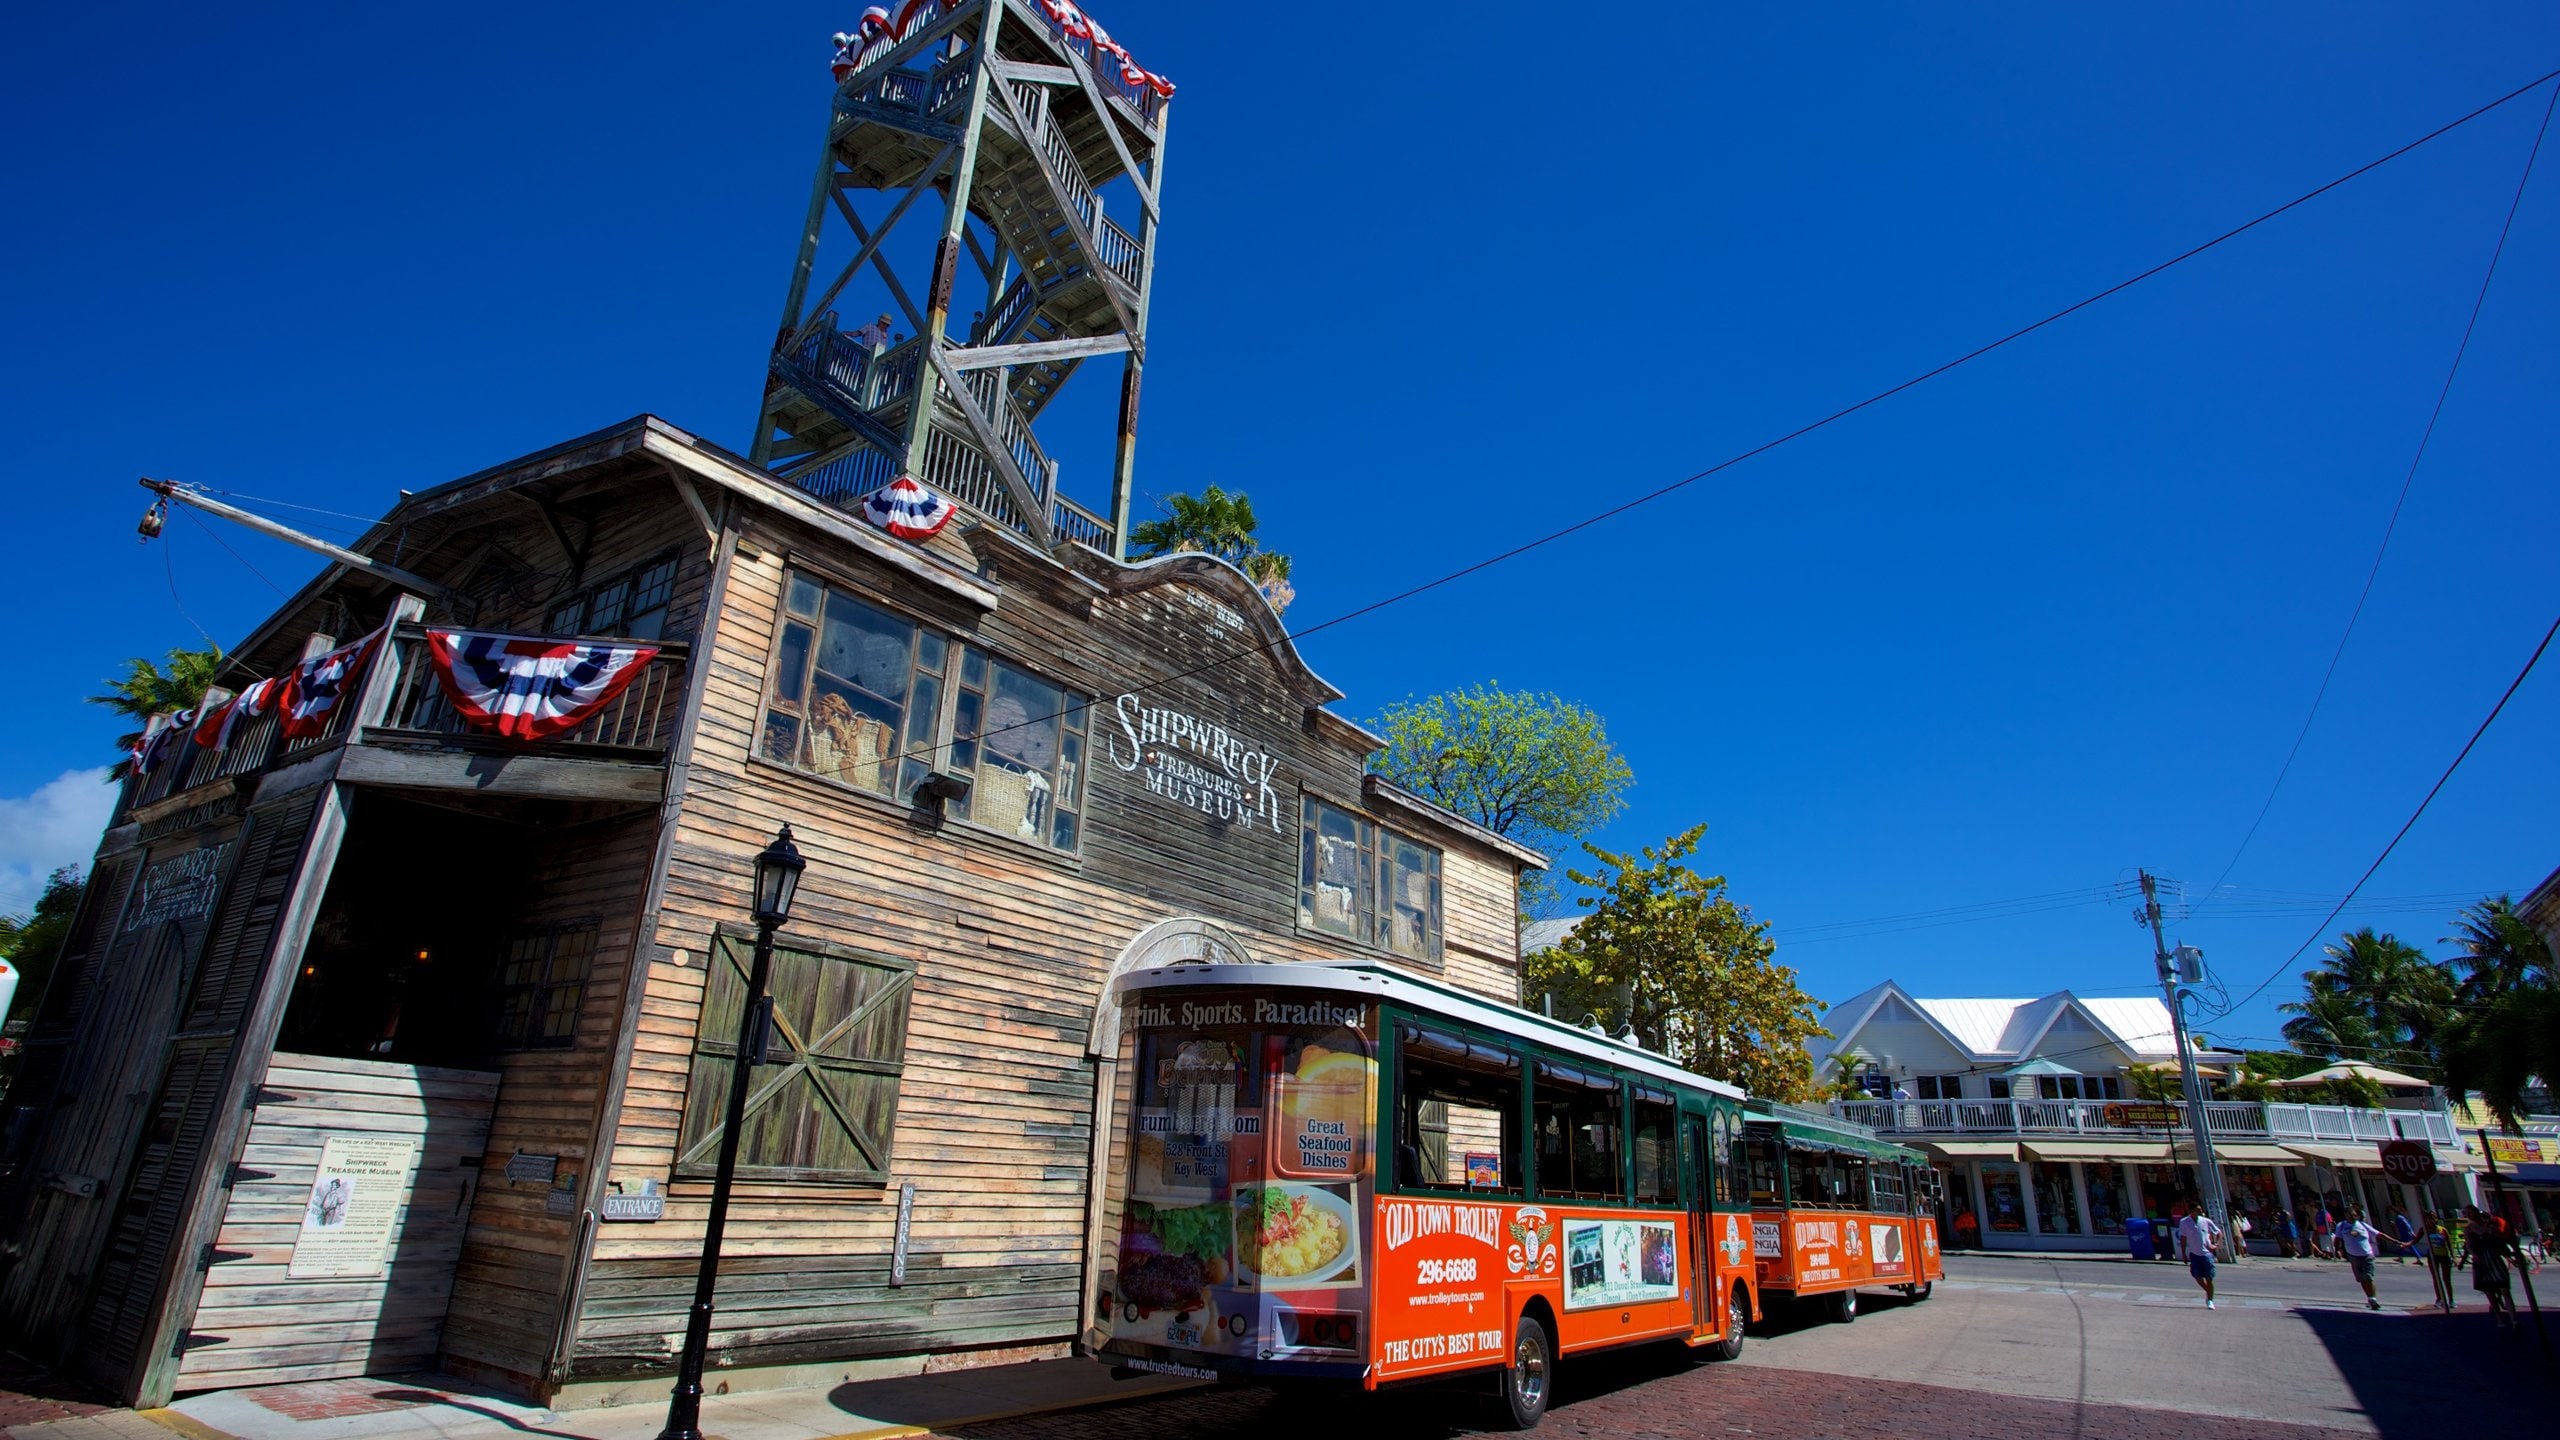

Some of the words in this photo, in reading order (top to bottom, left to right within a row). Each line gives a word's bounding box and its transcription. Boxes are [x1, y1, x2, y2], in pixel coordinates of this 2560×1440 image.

[1109, 693, 1281, 833] SHIPWRECK
[1156, 751, 1242, 801] TREASURES
[1145, 767, 1252, 829] MUSEUM
[1181, 1001, 1247, 1031] Sports.
[1254, 998, 1366, 1028] Paradise!
[2148, 1112, 2178, 1120] LOUGE
[1308, 1119, 1345, 1135] Great
[1166, 1144, 1184, 1157] 528
[1186, 1145, 1212, 1158] Front
[1215, 1144, 1228, 1158] St.
[1299, 1136, 1351, 1152] Seafood
[345, 1158, 387, 1166] SHIPWRECK
[1303, 1152, 1347, 1168] Dishes
[2385, 1154, 2431, 1172] STOP
[1174, 1162, 1191, 1177] Key
[1194, 1162, 1218, 1177] West
[549, 1192, 575, 1204] ENTRANCE
[903, 1187, 913, 1197] NO
[607, 1199, 660, 1216] ENTRANCE
[1386, 1203, 1414, 1251] OLD
[1416, 1204, 1451, 1238] TOWN
[1454, 1205, 1502, 1250] TROLLEY
[894, 1199, 911, 1278] PARKING
[1417, 1258, 1476, 1285] 296-6688
[1409, 1292, 1484, 1306] www.trolleytours.com
[1385, 1340, 1409, 1363] THE
[1412, 1333, 1444, 1360] CITY'S
[1448, 1333, 1475, 1355] BEST
[1478, 1330, 1502, 1350] TOUR
[1128, 1357, 1217, 1381] www.trustedtours.com
